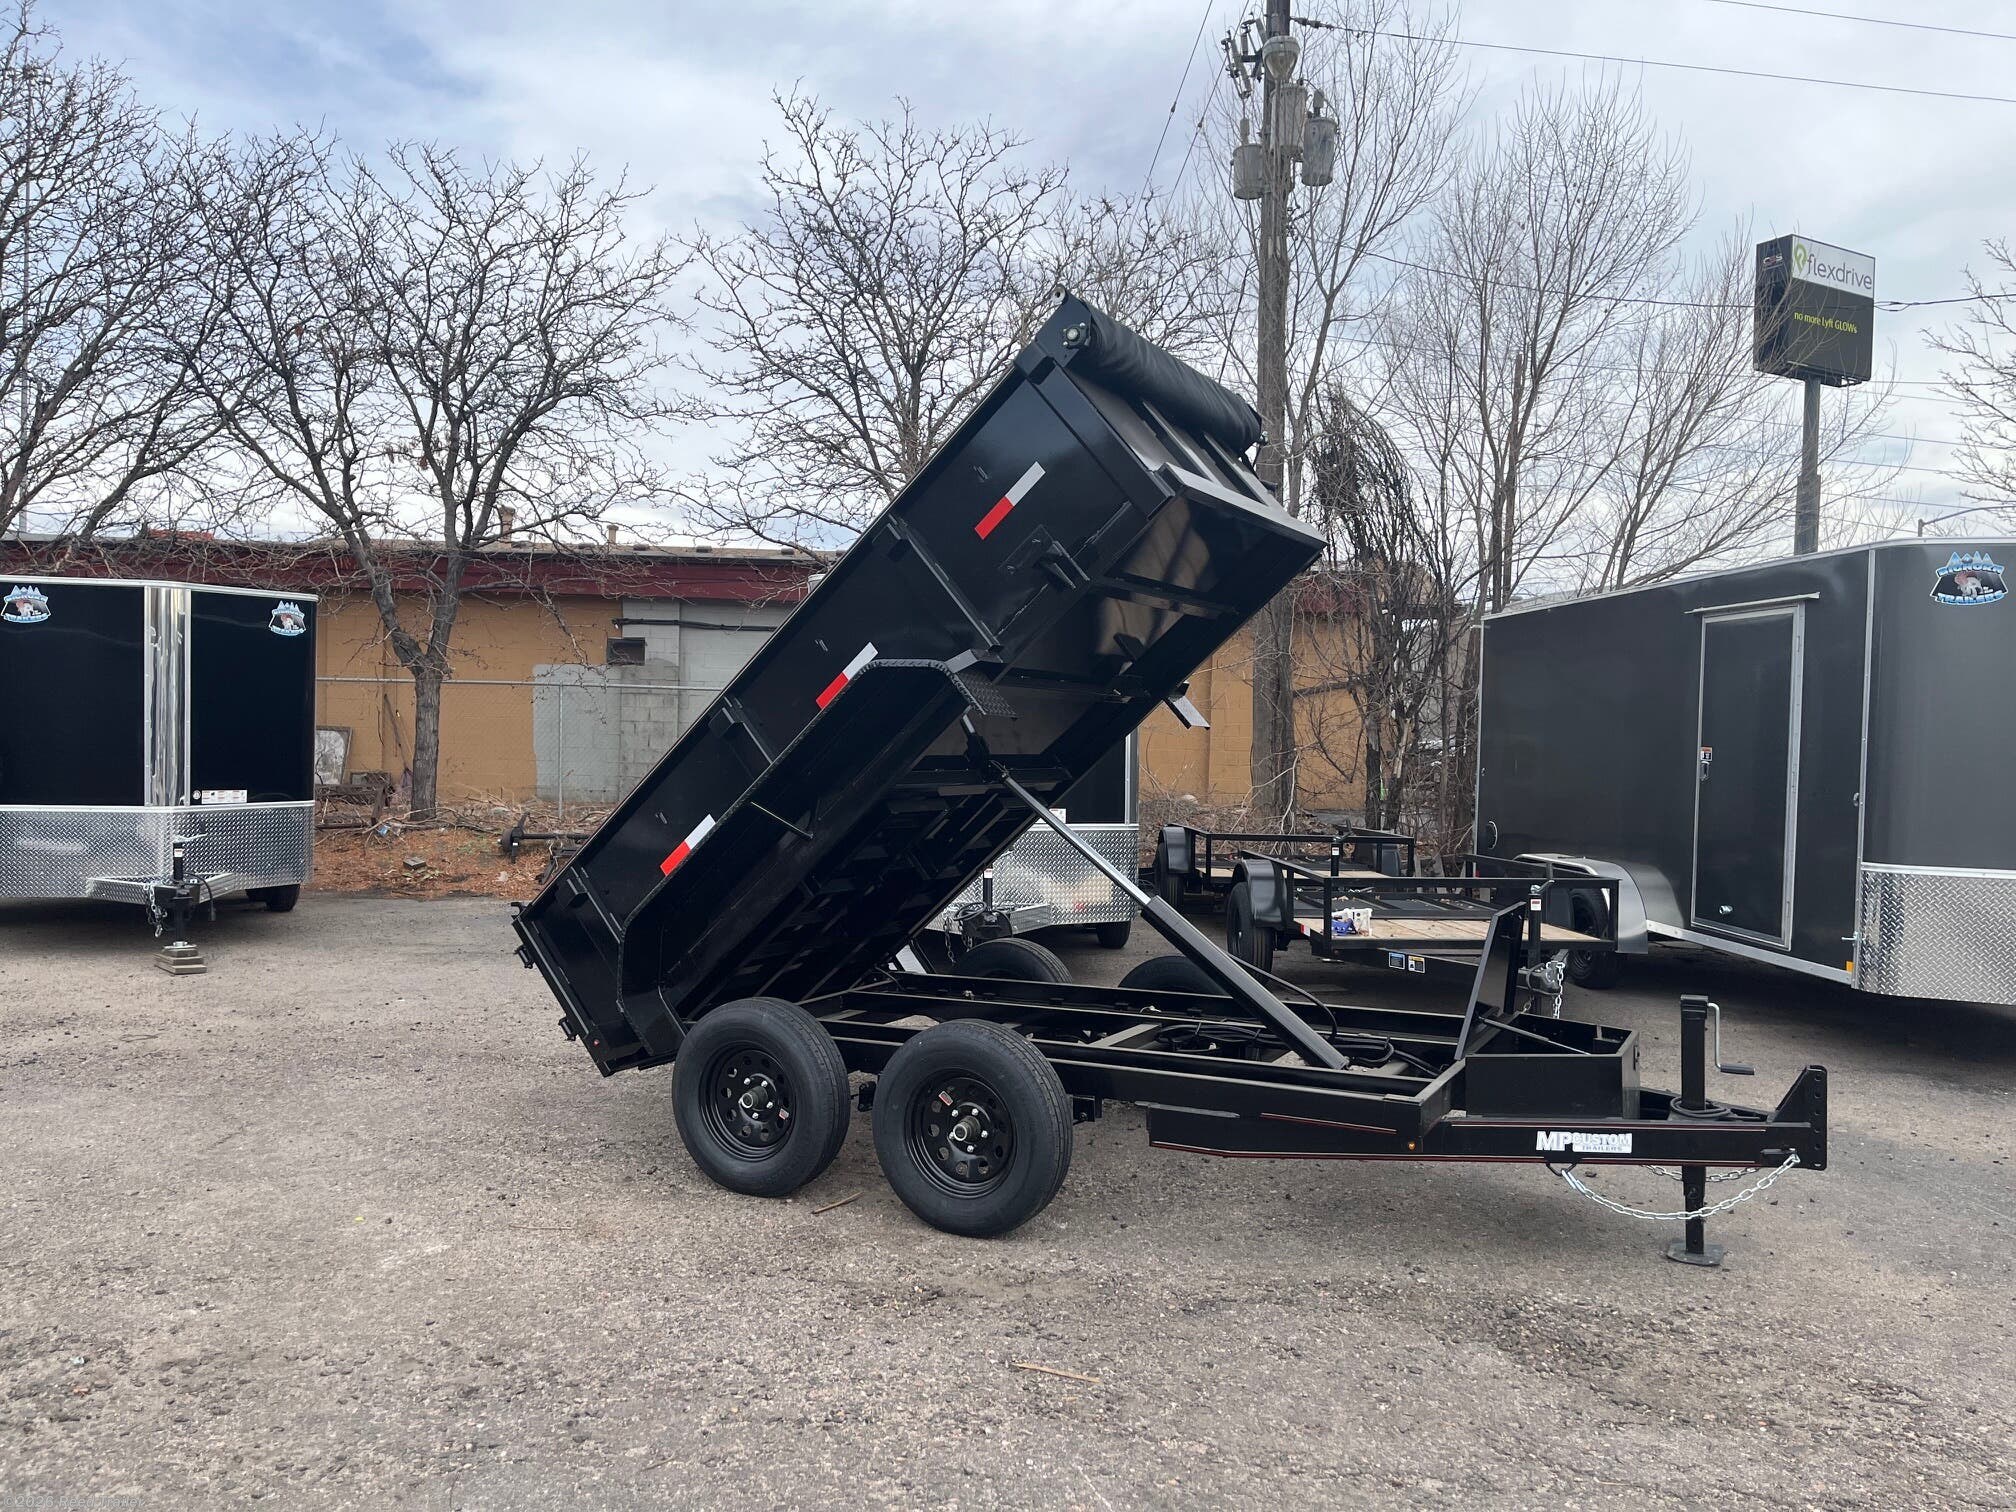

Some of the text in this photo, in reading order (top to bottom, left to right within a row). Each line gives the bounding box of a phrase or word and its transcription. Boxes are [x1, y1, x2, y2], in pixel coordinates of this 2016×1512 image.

[1807, 253, 1873, 290] flexdrive
[1794, 312, 1804, 321] no
[1804, 314, 1821, 326] more
[1936, 590, 2005, 605] TRAILERS
[1536, 1130, 1632, 1151] MP CUSTOM
